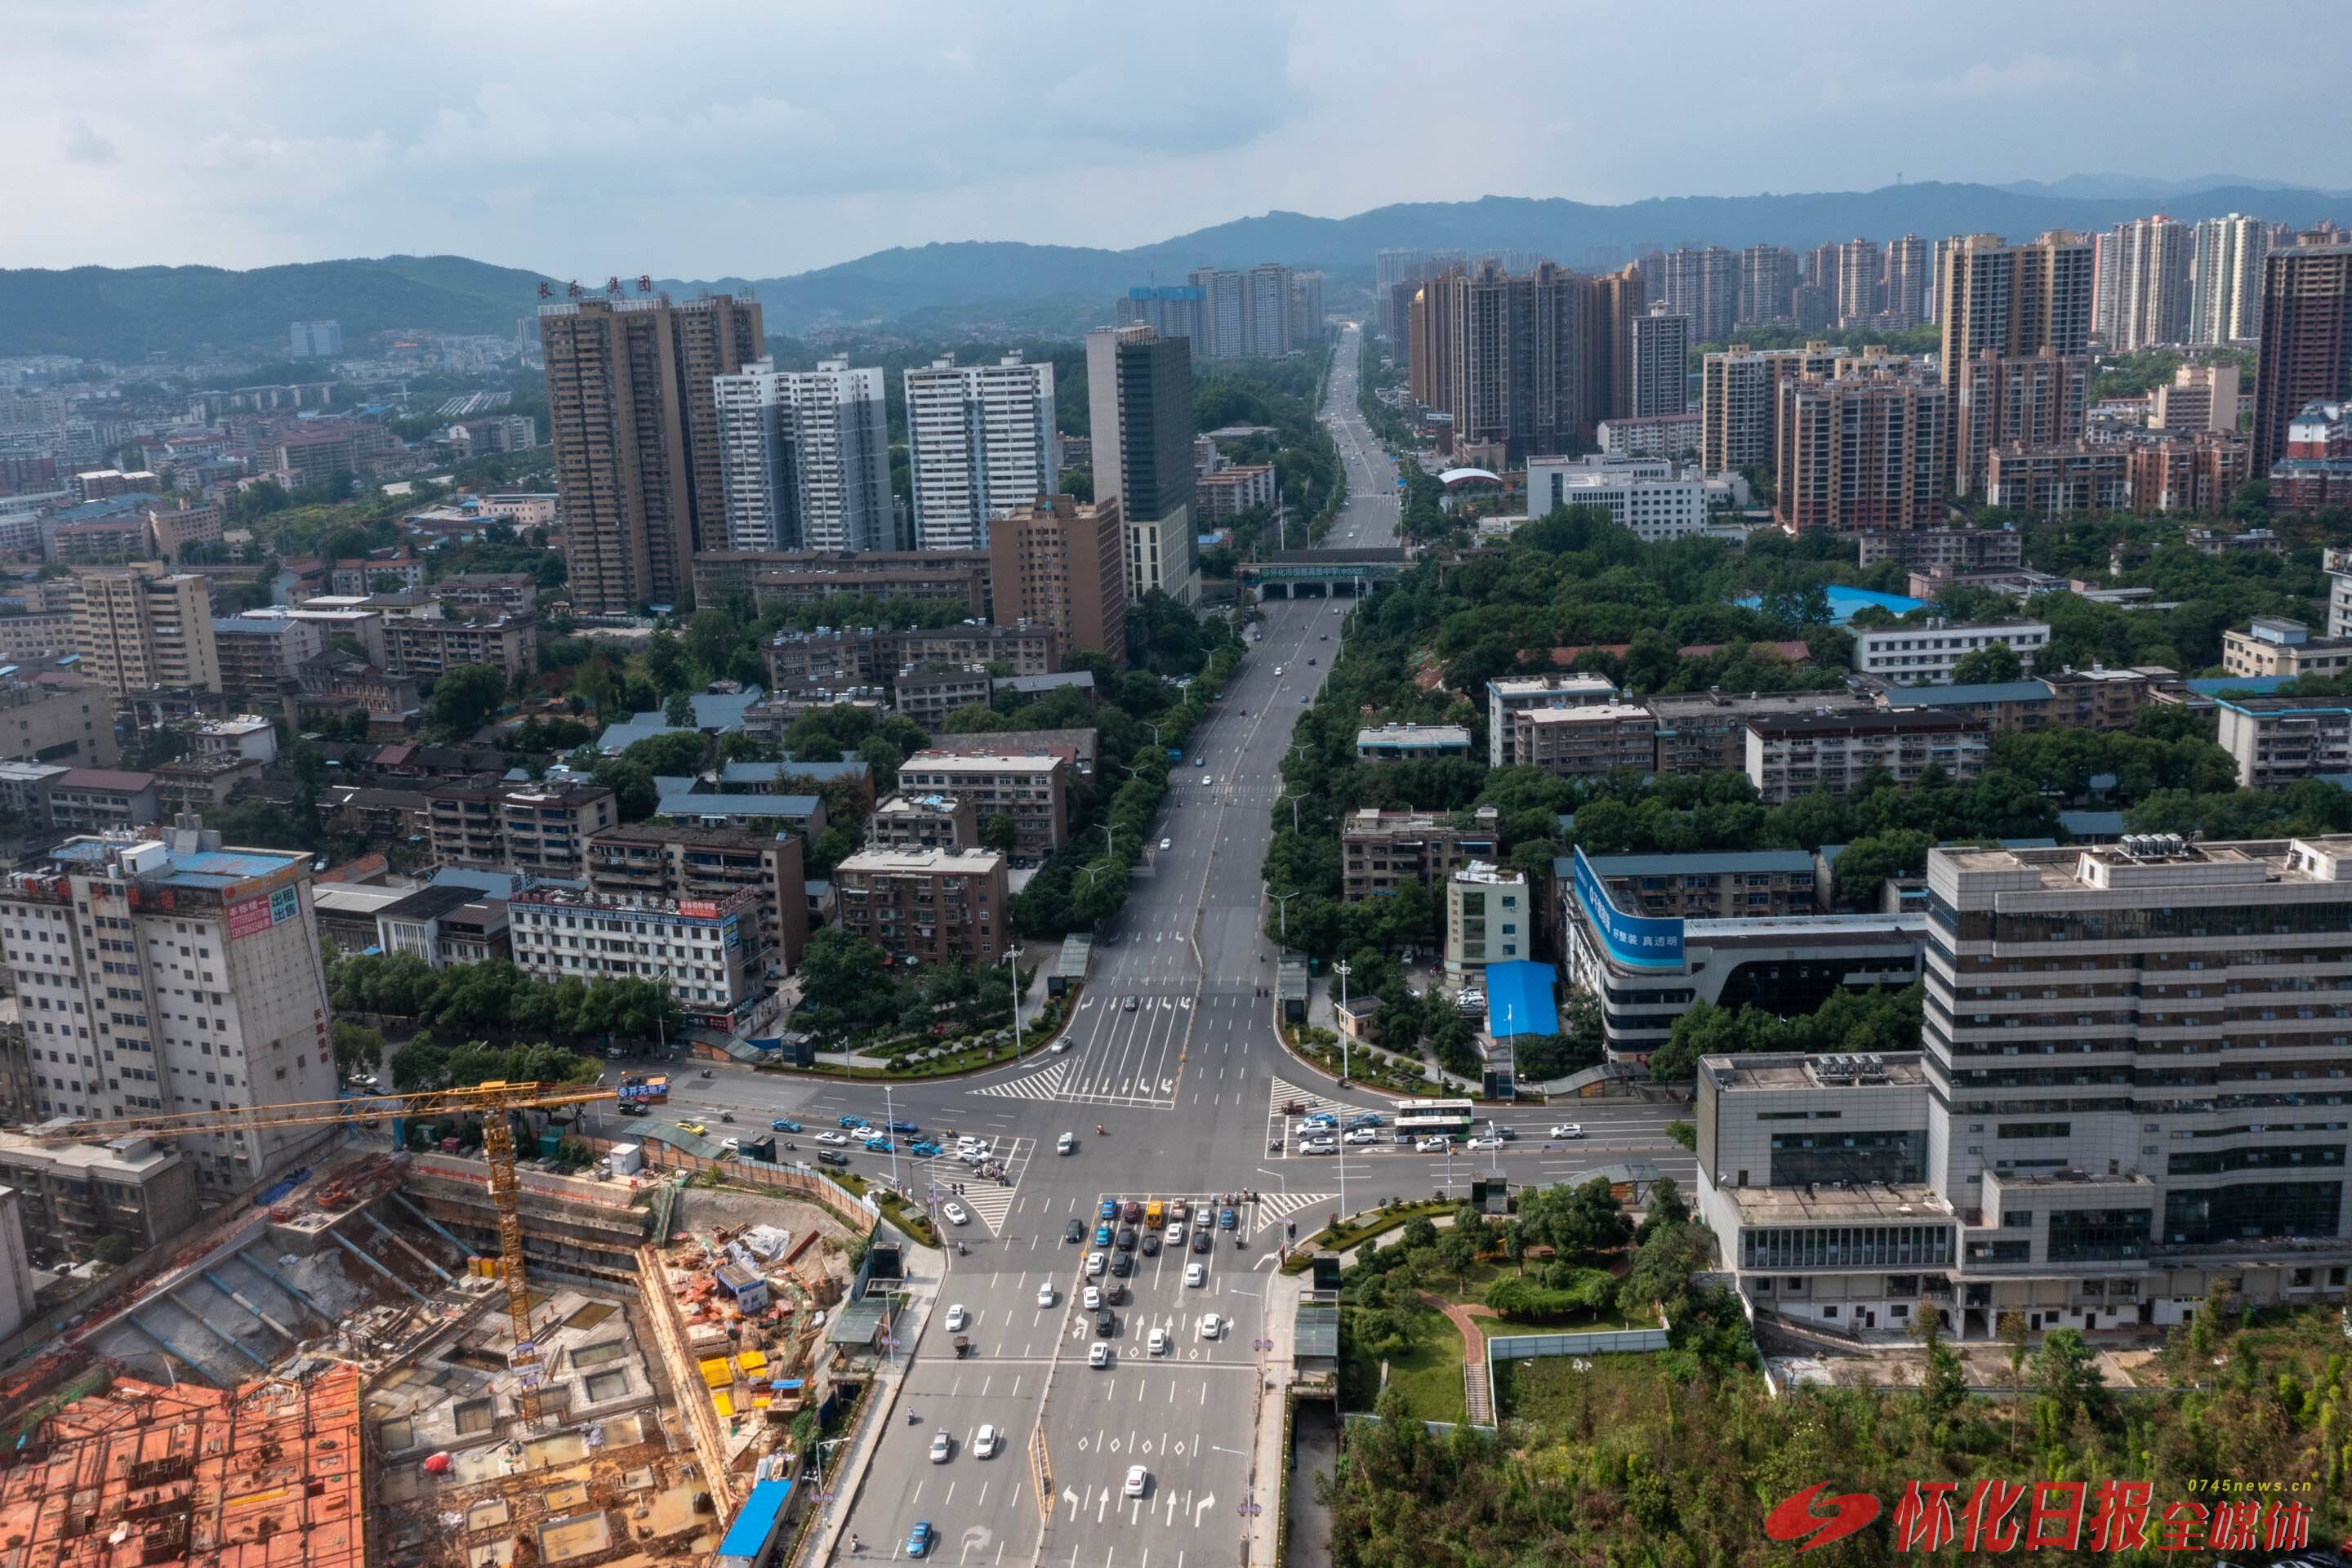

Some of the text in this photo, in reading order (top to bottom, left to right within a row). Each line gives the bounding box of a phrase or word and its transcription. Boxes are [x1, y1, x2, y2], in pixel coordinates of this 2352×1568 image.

[270, 889, 295, 908] 出租
[274, 903, 296, 922] 出售
[1613, 928, 1677, 947] 好整装 真透明
[629, 1085, 667, 1096] 开元地产
